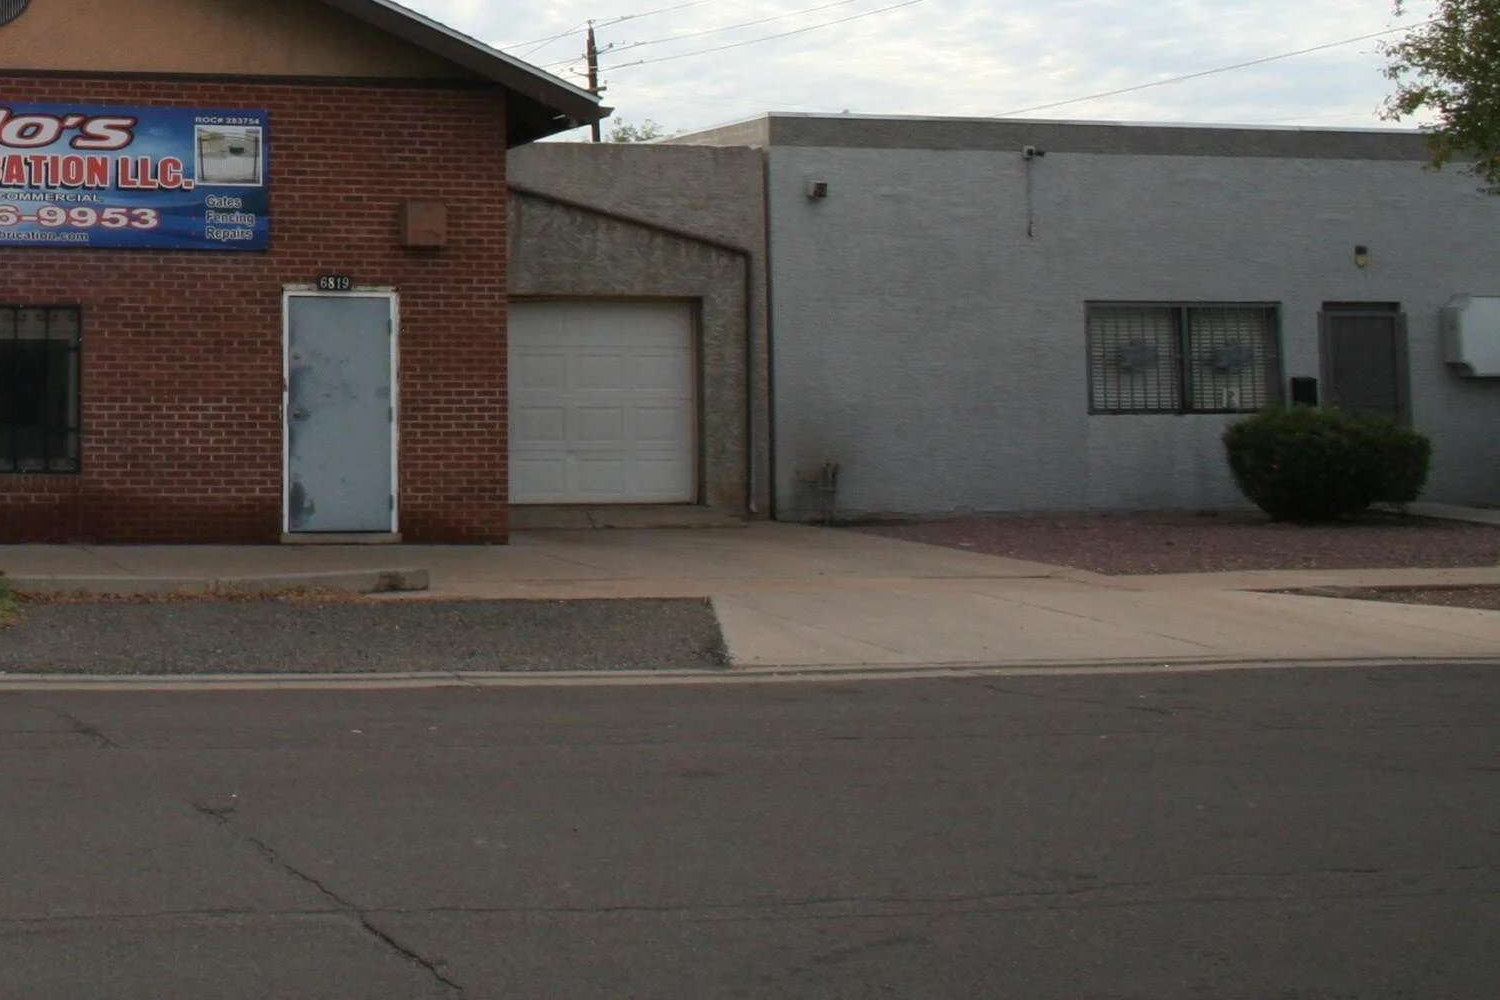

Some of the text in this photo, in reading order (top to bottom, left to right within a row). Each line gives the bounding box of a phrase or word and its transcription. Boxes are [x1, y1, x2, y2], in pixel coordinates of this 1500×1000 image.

[118, 156, 194, 189] LLC.
[205, 194, 242, 208] Gates
[205, 210, 255, 227] Fencing
[205, 225, 253, 241] Repairs
[320, 276, 349, 289] 6819
